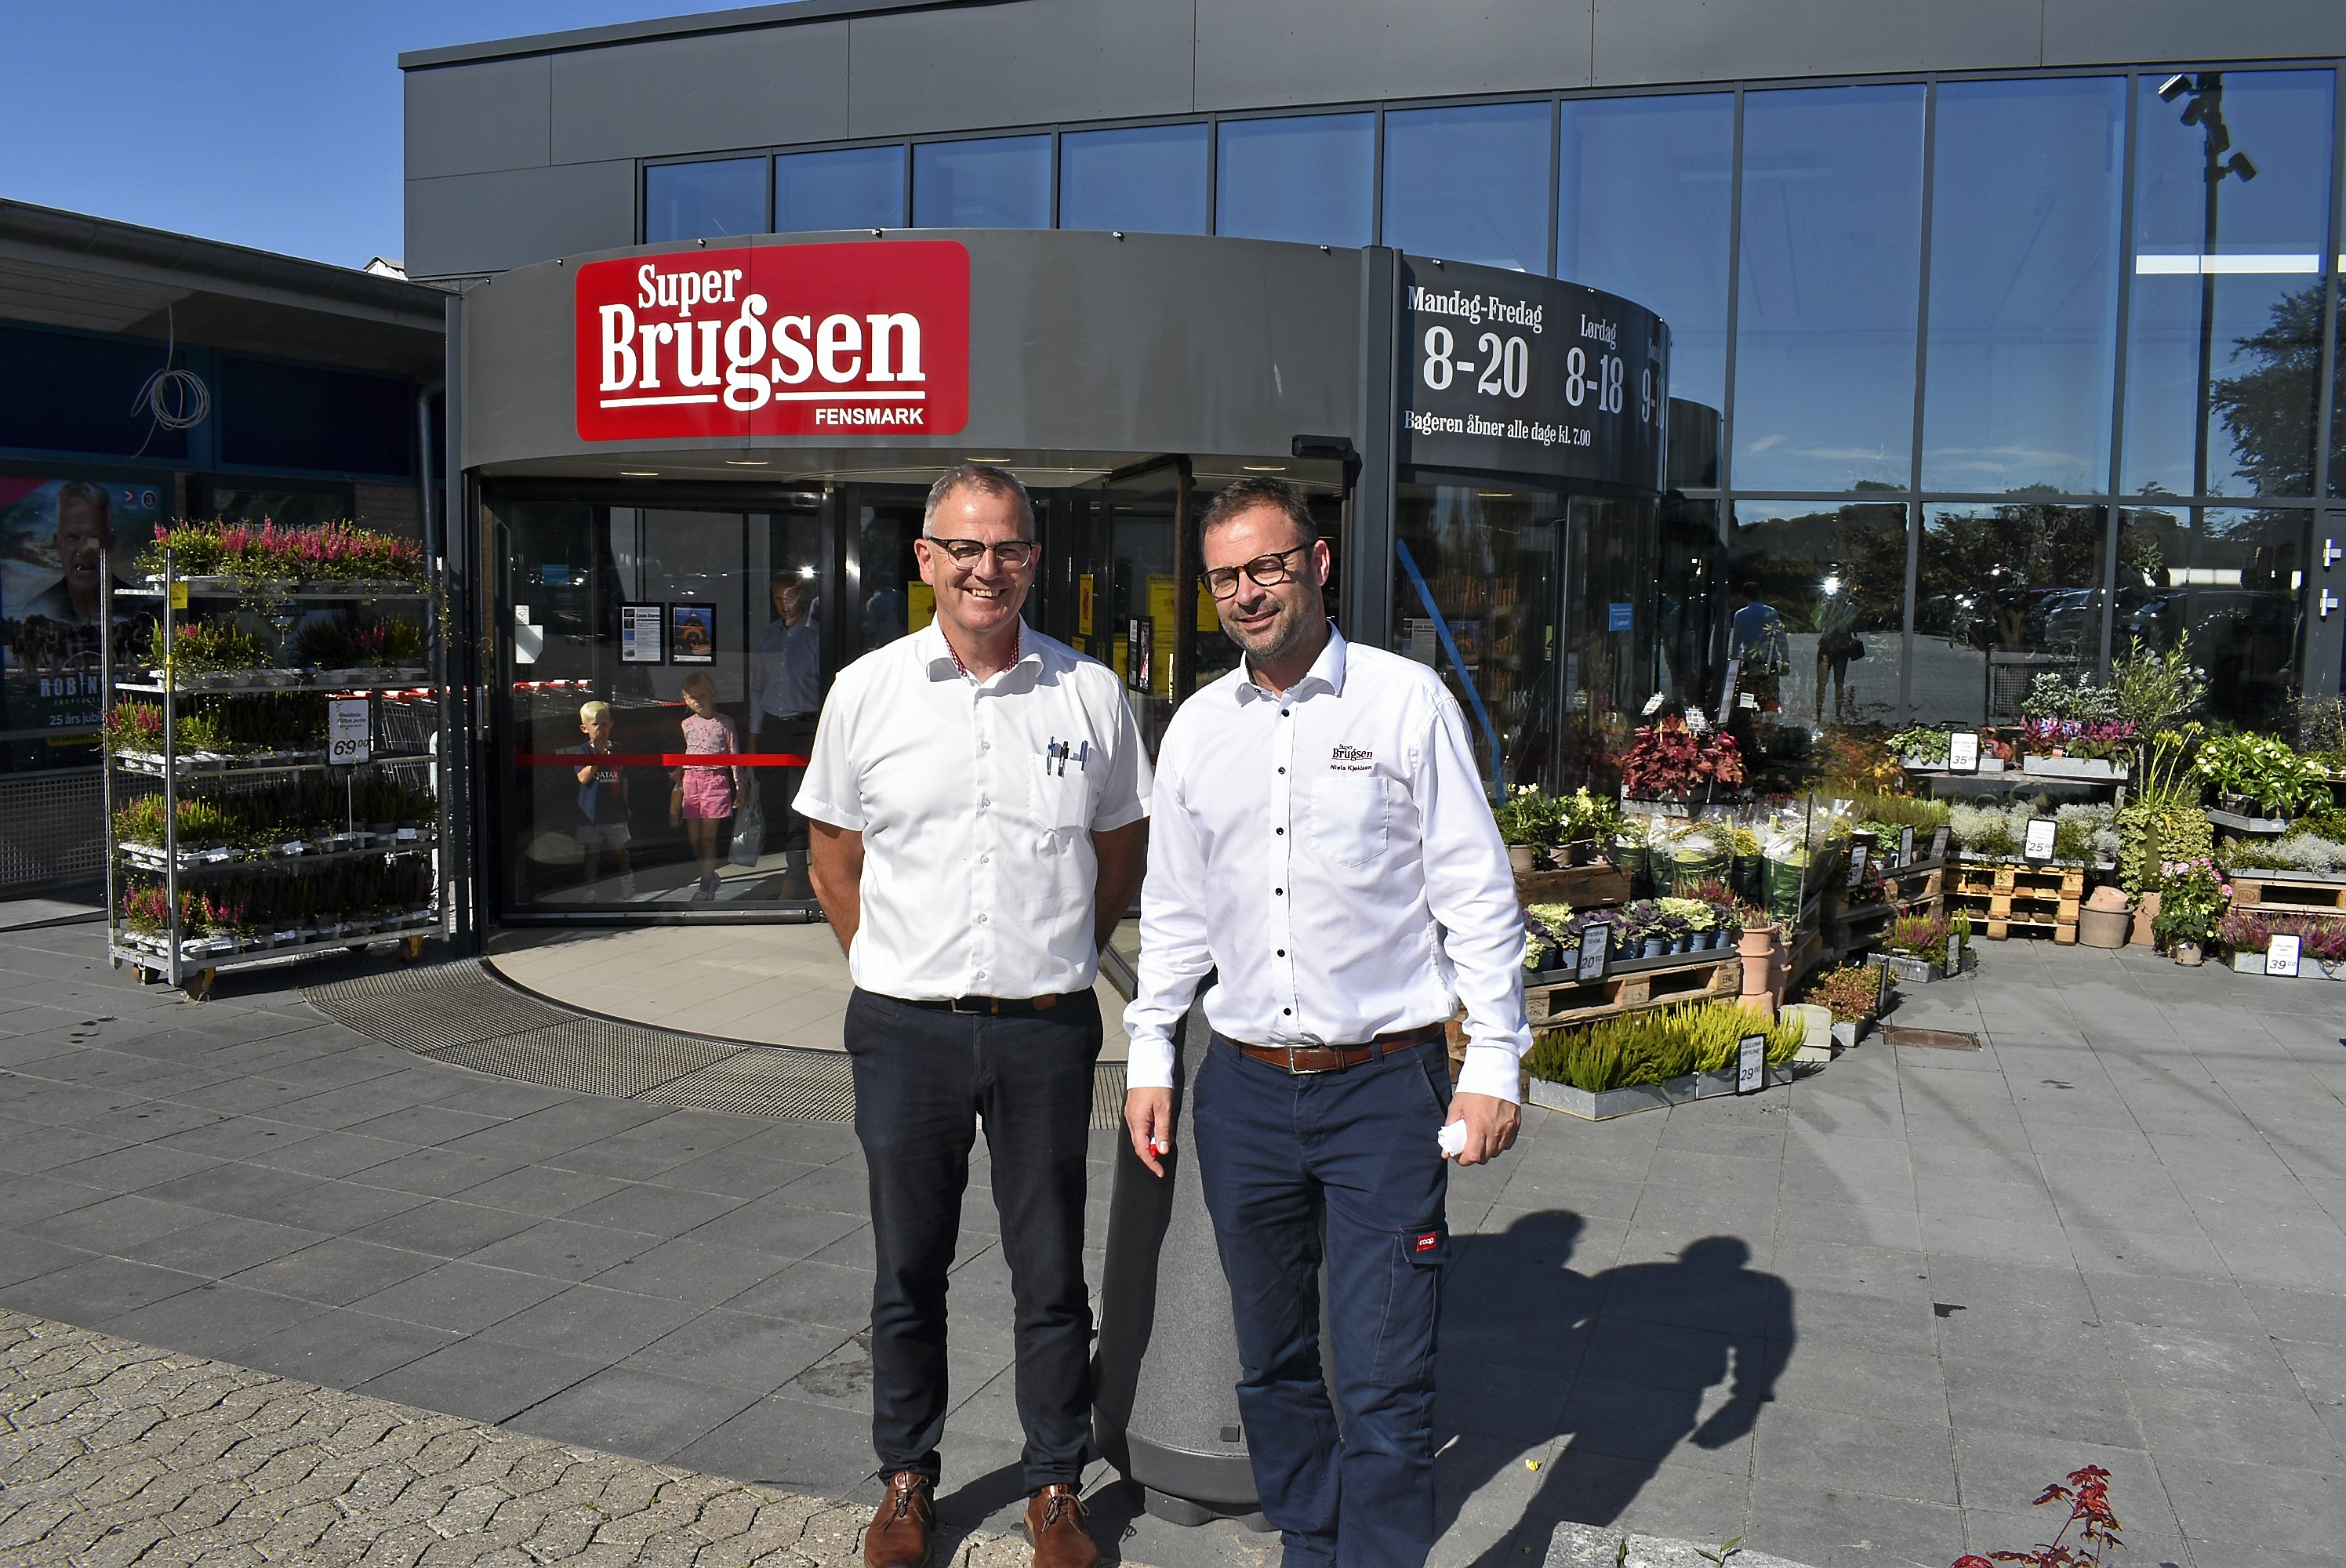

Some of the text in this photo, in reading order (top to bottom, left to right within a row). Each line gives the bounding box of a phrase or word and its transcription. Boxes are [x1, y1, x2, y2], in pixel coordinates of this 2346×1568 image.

[638, 264, 742, 317] Super
[1408, 285, 1542, 333] Mandag-Fredag
[1580, 314, 1617, 350] Lørdag
[599, 293, 926, 411] Brugsen
[1423, 325, 1528, 398] 8-20
[1566, 347, 1624, 414] 8-18
[815, 408, 924, 425] FENSMARK
[1405, 410, 1591, 447] Bageren åbner alle dage kl. 7.00
[49, 710, 103, 726] 25 års jubil
[334, 739, 357, 756] 69
[1332, 747, 1373, 761] Brugsen
[1952, 755, 1968, 764] 35
[2028, 842, 2044, 852] 25
[1580, 956, 1595, 970] 20
[2269, 960, 2286, 970] 39
[1740, 1067, 1754, 1081] 29
